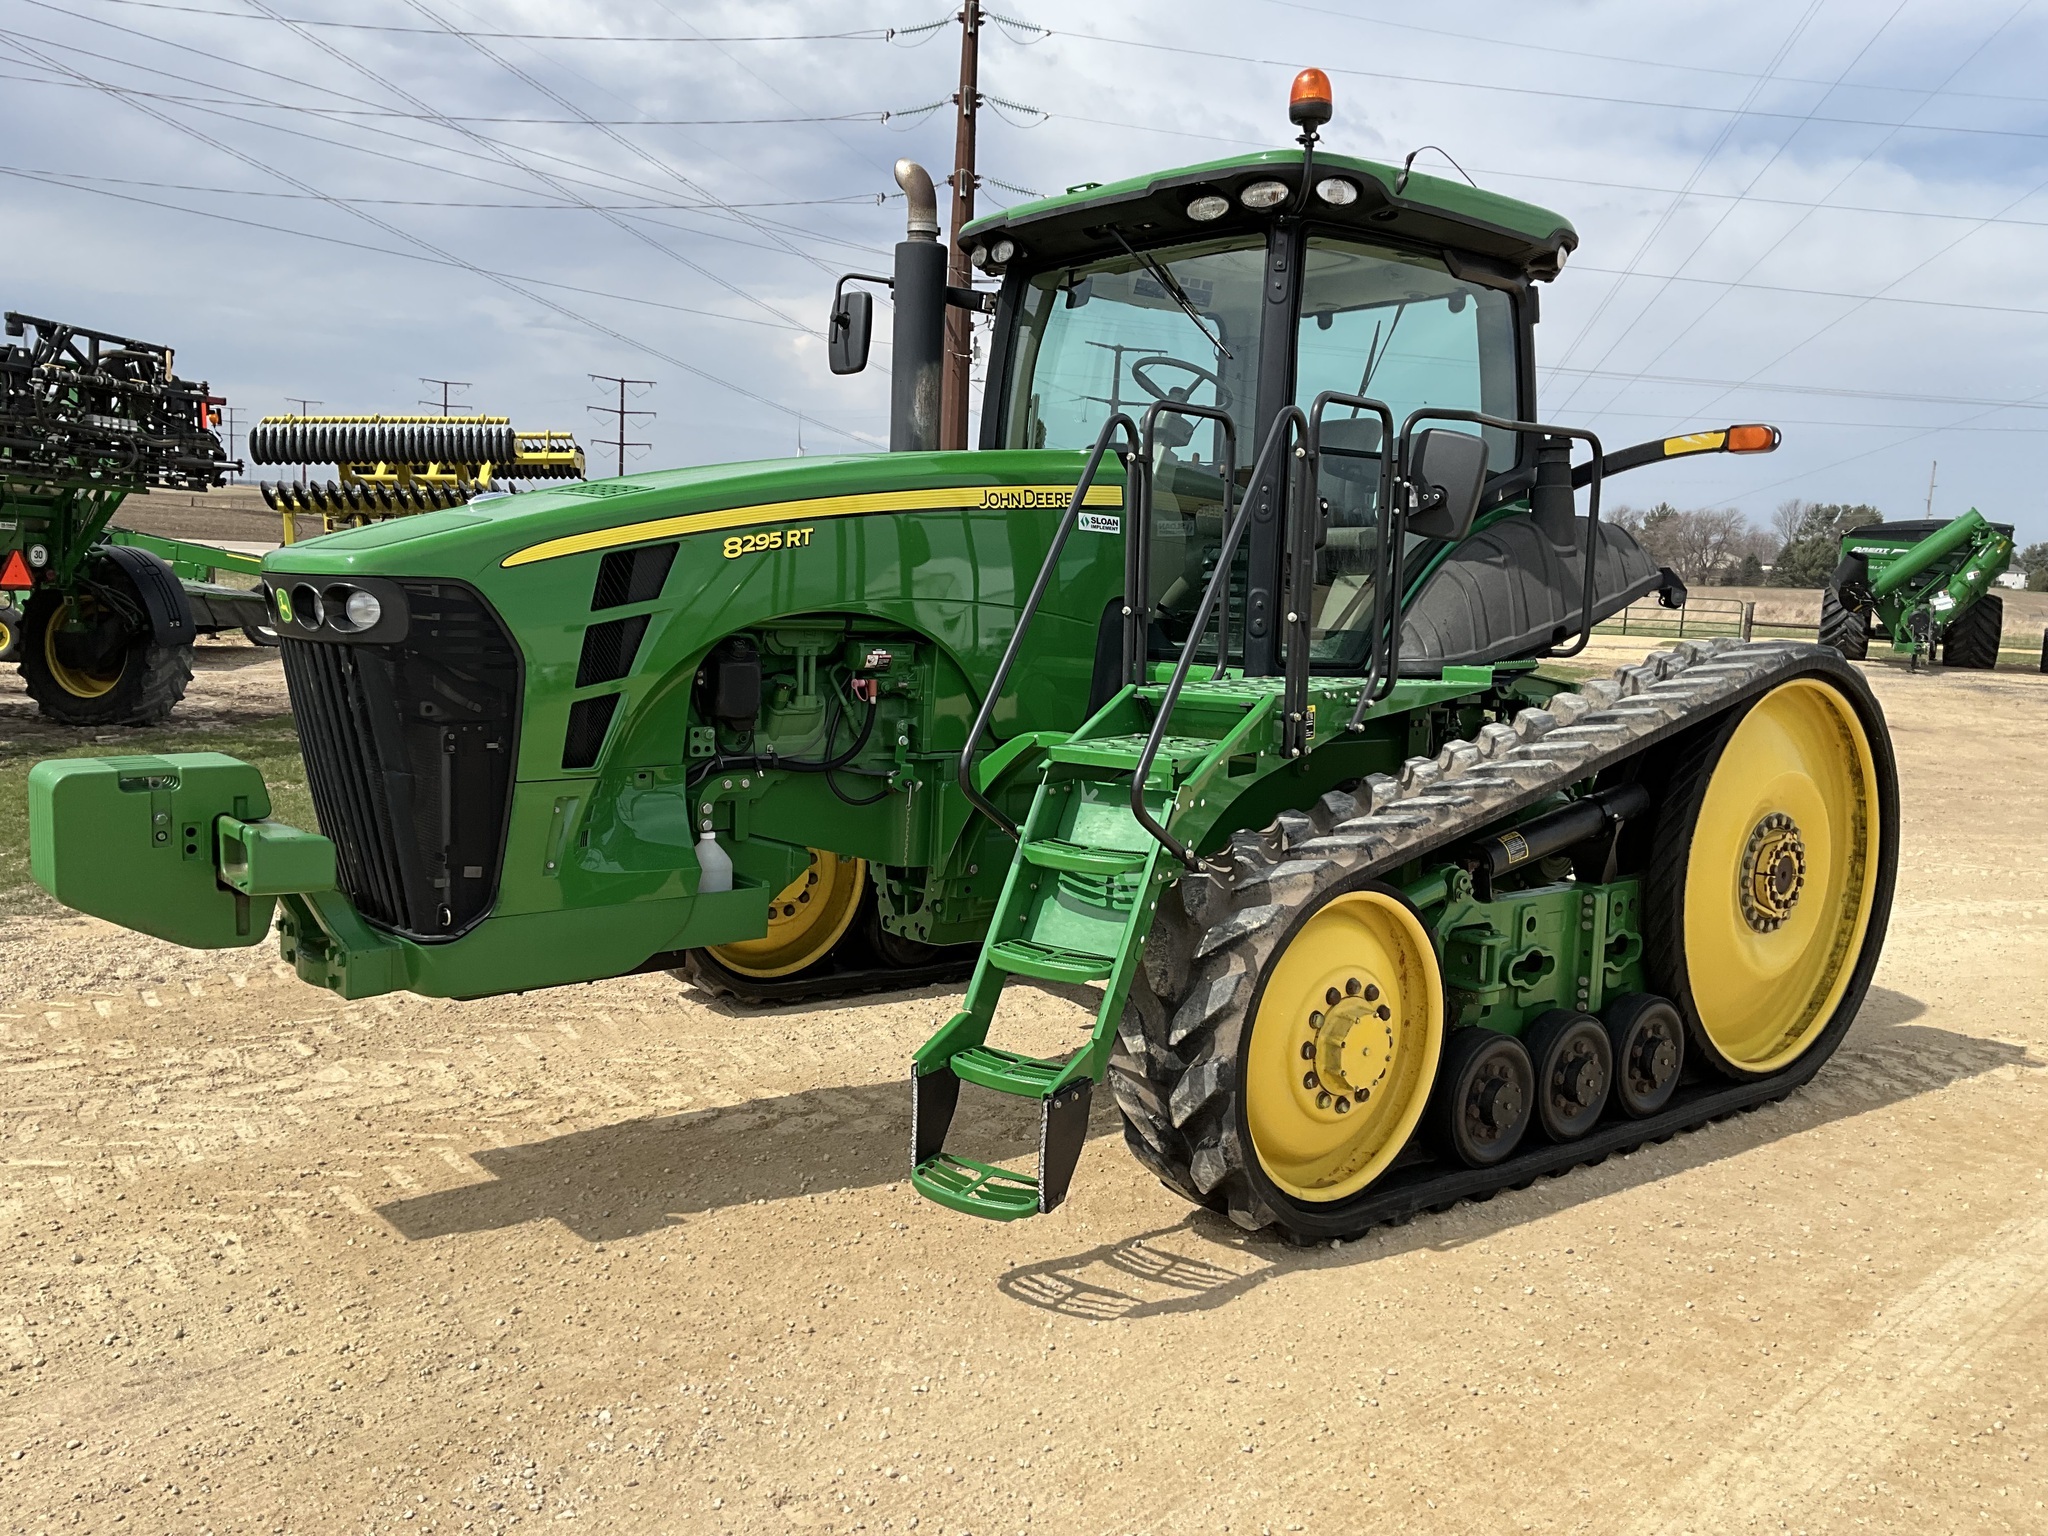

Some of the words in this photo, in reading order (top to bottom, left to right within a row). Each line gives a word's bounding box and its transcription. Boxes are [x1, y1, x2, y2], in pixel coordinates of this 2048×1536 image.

[979, 490, 1022, 508] JOHN
[1023, 489, 1073, 508] DEERE
[1090, 516, 1119, 526] SLOAN
[723, 530, 783, 559] 8295
[786, 527, 815, 548] RT
[33, 550, 43, 559] 30
